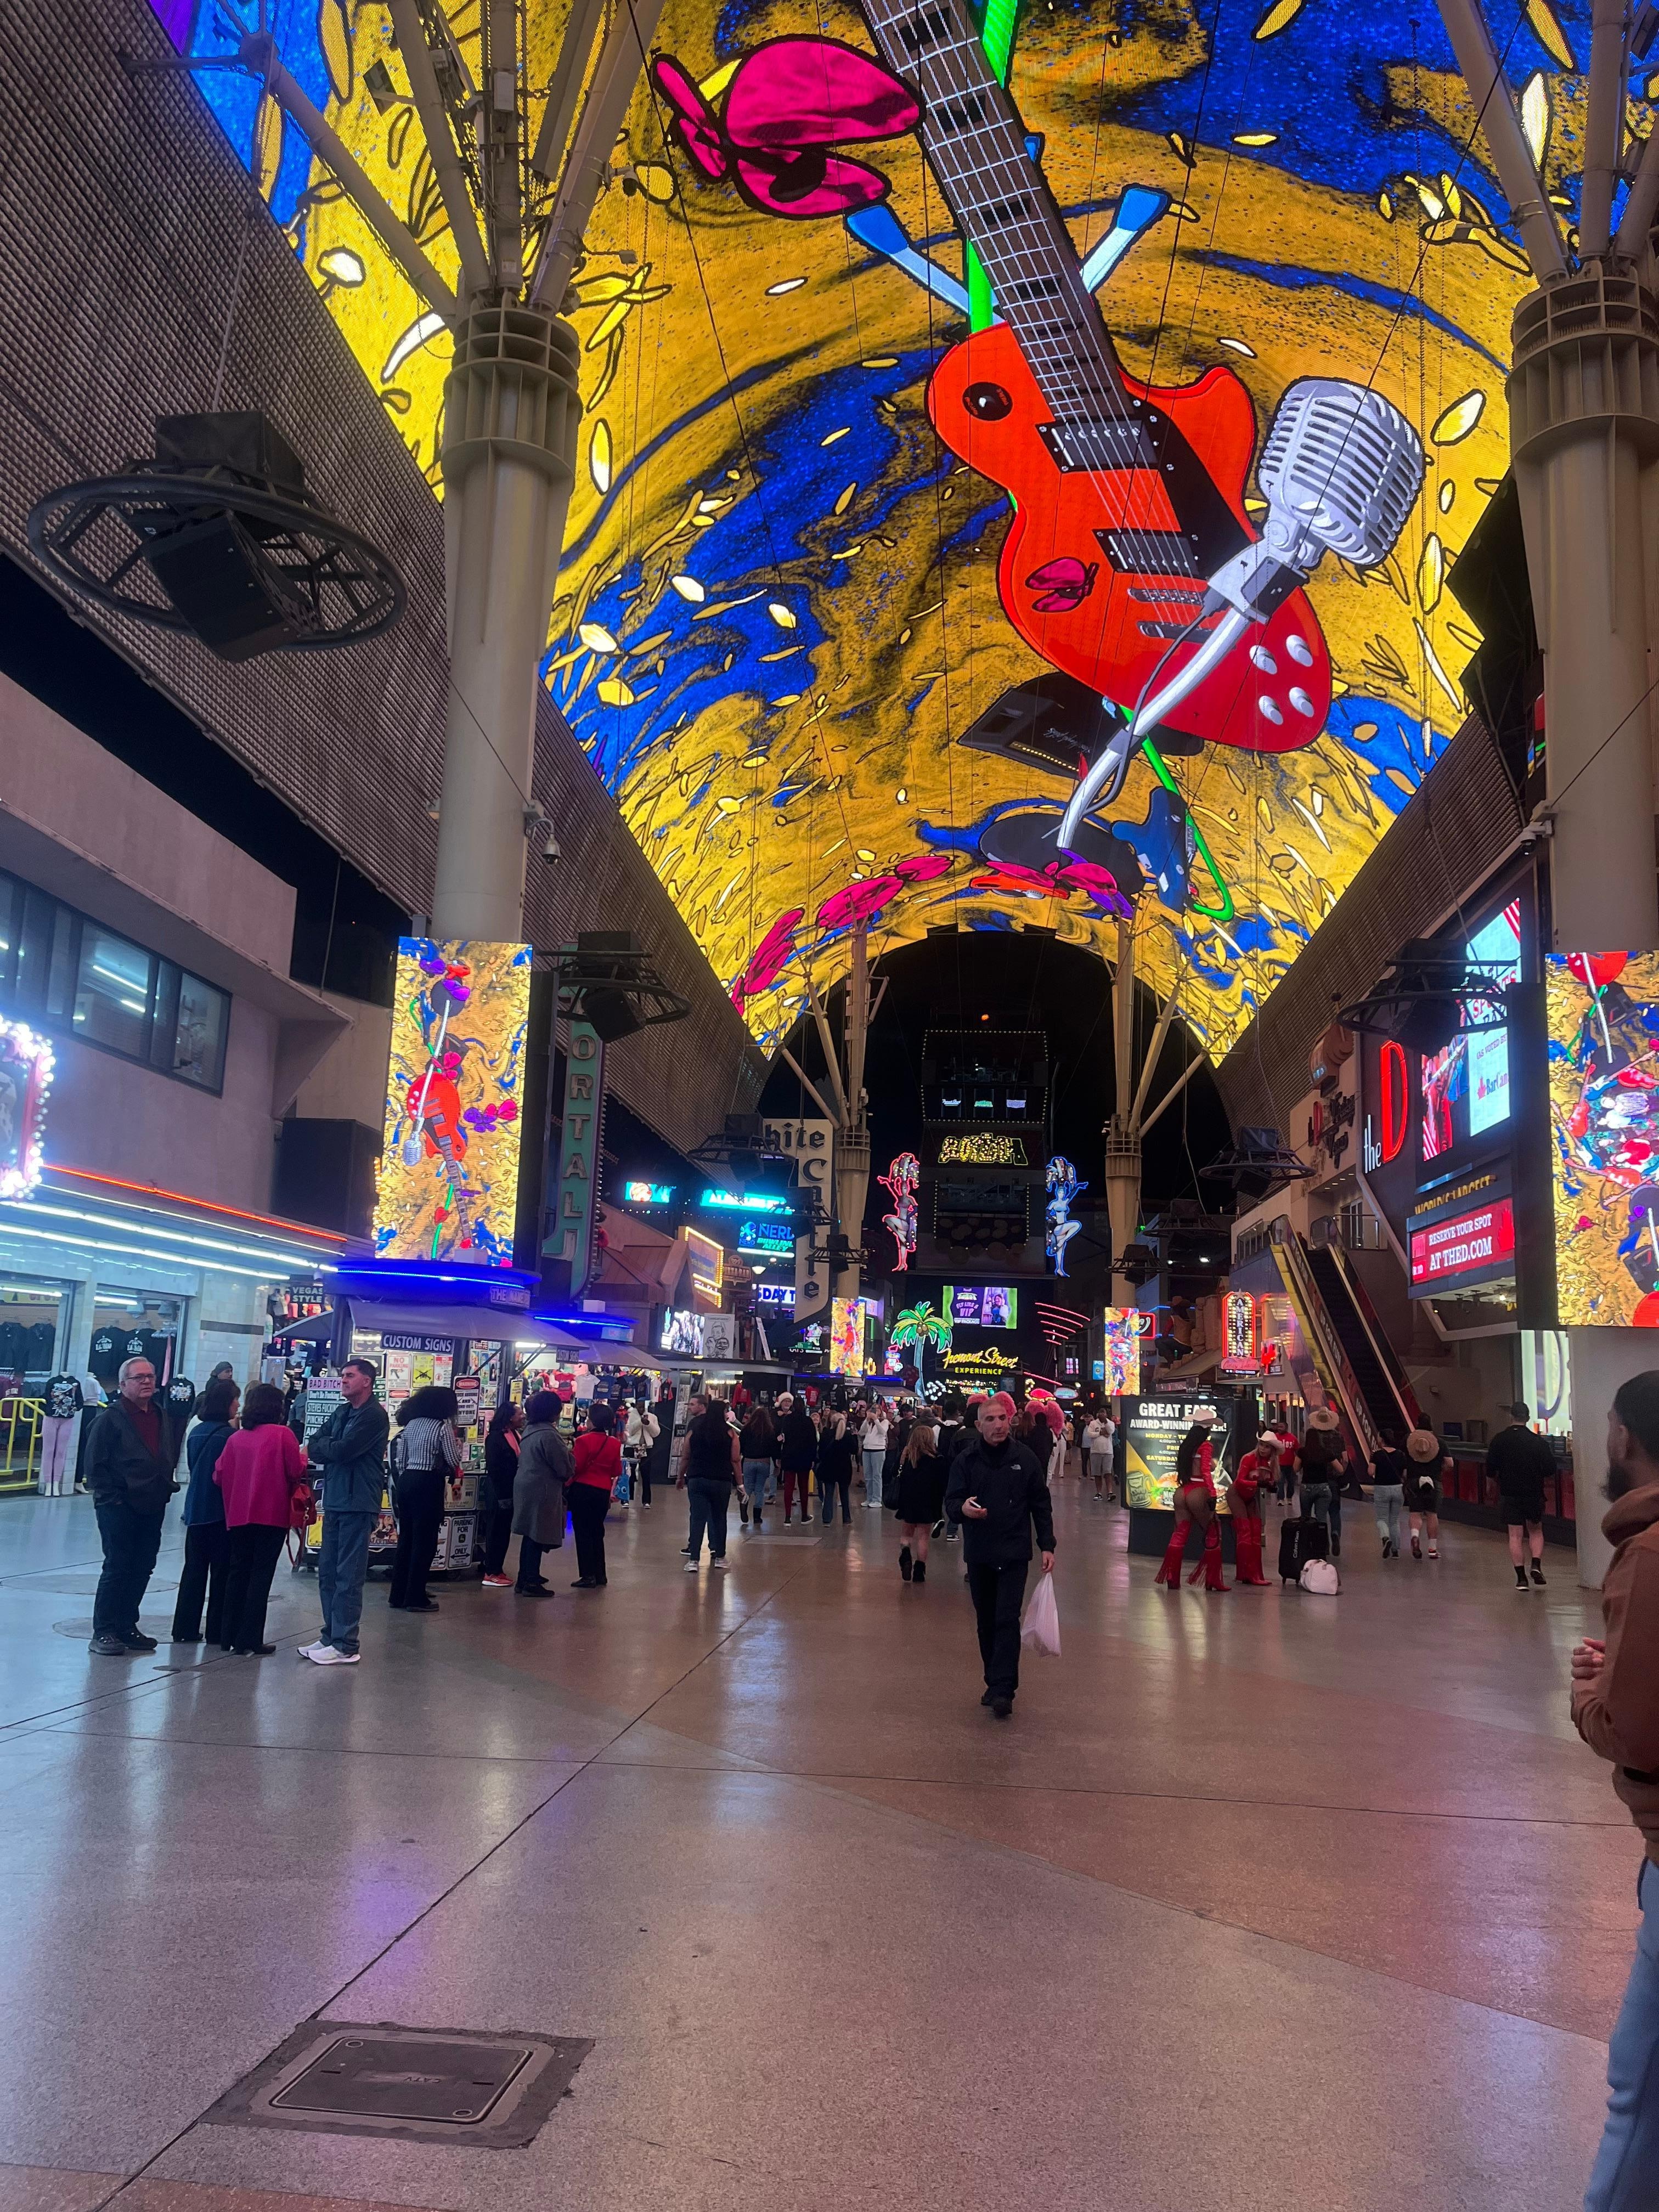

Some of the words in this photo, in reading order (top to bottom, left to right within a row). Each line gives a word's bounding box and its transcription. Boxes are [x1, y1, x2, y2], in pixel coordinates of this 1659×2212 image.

[1364, 1114, 1381, 1173] the
[1380, 1040, 1409, 1163] D
[765, 1122, 825, 1153] hite
[1429, 1226, 1456, 1246] RESERVE
[1456, 1220, 1473, 1237] YOUR
[1474, 1213, 1492, 1230] SPOT
[762, 1243, 788, 1252] ALLEY
[1429, 1252, 1442, 1271] AT
[1443, 1236, 1493, 1267] THED.COM
[292, 1286, 323, 1295] VEGAS
[960, 1308, 974, 1317] VIP
[1236, 1299, 1244, 1357] AMERICAN
[384, 1334, 422, 1349] CUSTOM
[425, 1338, 452, 1352] SIGNS
[943, 1347, 984, 1369] Fremont
[981, 1347, 1019, 1369] Street
[955, 1367, 1002, 1375] EXPERIENCE
[309, 1379, 321, 1388] BAD
[323, 1380, 341, 1388] BITCH
[1139, 1403, 1181, 1418] GREAT
[1130, 1419, 1194, 1431] AWARD-WINNIN
